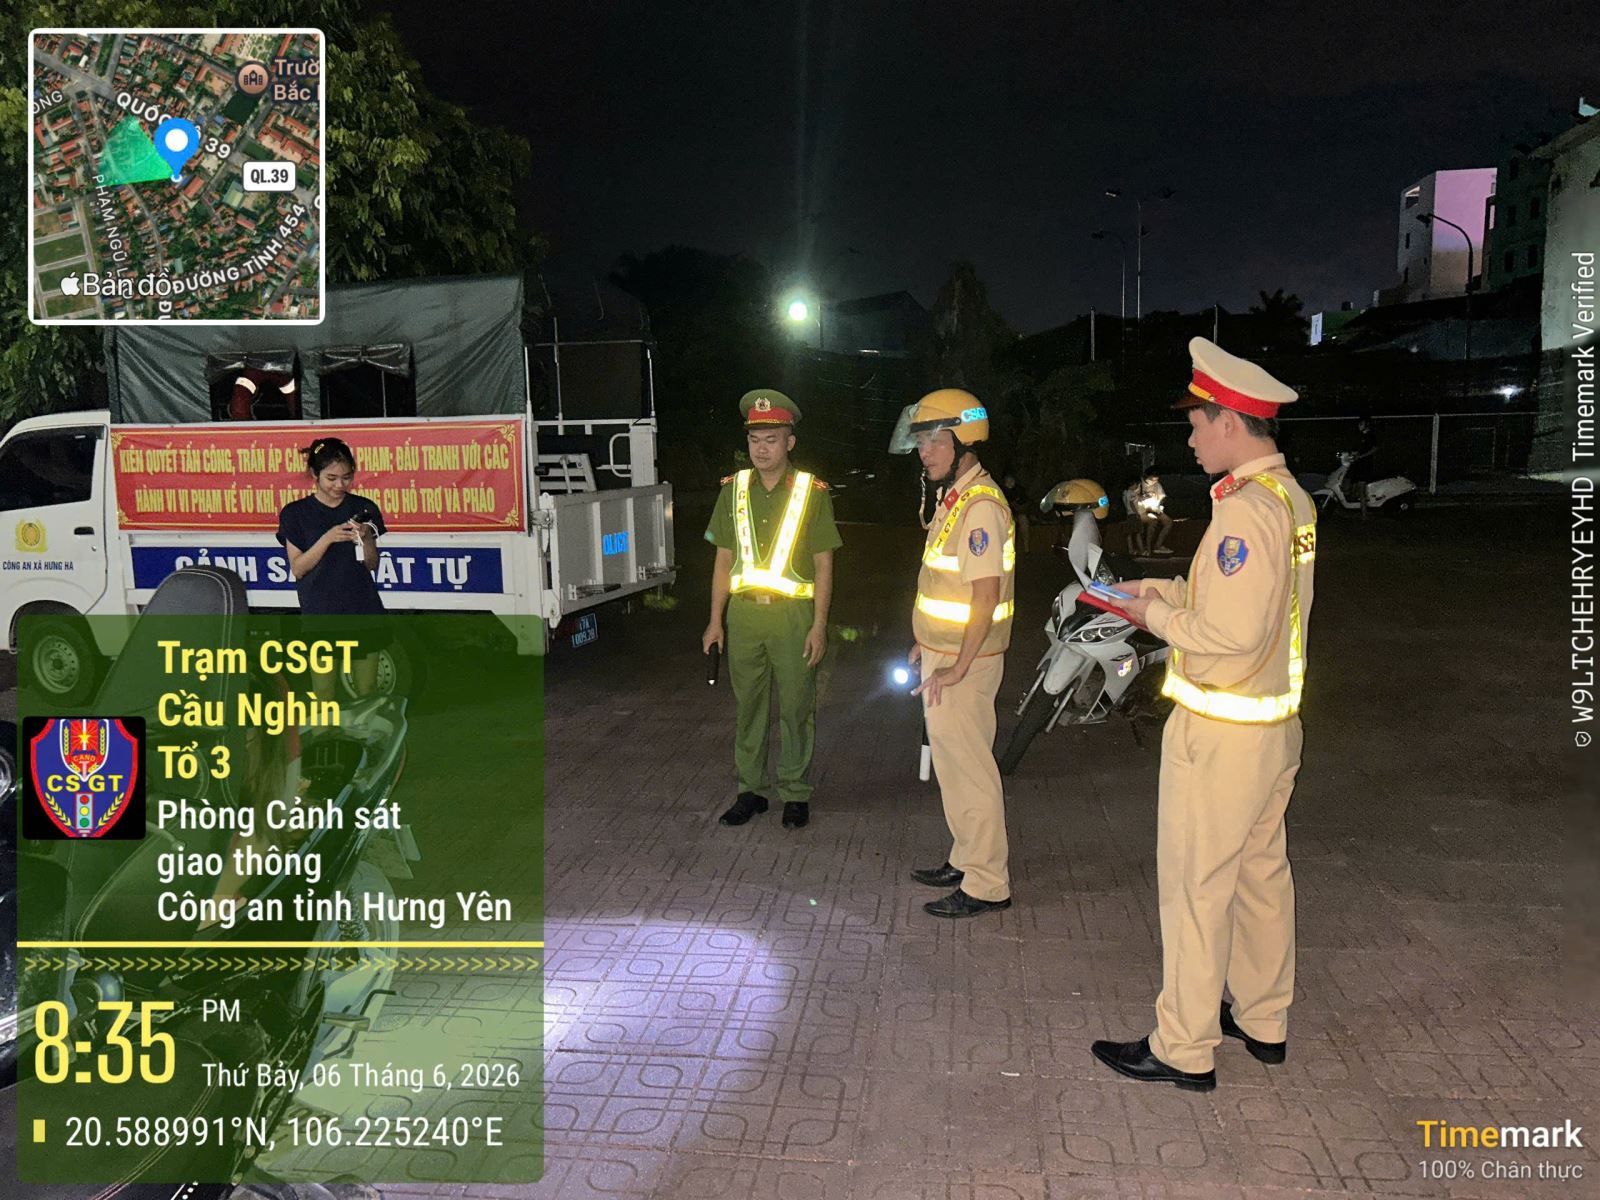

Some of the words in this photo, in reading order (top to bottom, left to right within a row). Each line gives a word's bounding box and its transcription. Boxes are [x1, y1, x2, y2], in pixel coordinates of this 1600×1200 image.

[120, 444, 144, 473] KIÊN
[145, 441, 178, 476] QUYẾT
[179, 440, 200, 473] TẤN
[237, 440, 266, 473] TRẤN
[268, 443, 283, 473] ÁP
[421, 445, 460, 471] TRANH
[461, 439, 482, 471] VỚI
[484, 438, 509, 470] CÁC
[135, 484, 164, 513] HÀNH
[165, 488, 177, 513] VI
[178, 488, 189, 513] VI
[190, 488, 222, 518] PHẠM
[384, 488, 399, 518] CỤ
[420, 485, 442, 519] TRỢ
[444, 482, 460, 513] VÀ
[463, 482, 495, 513] PHÁO
[22, 561, 31, 570] AN
[427, 555, 472, 590] TỰ
